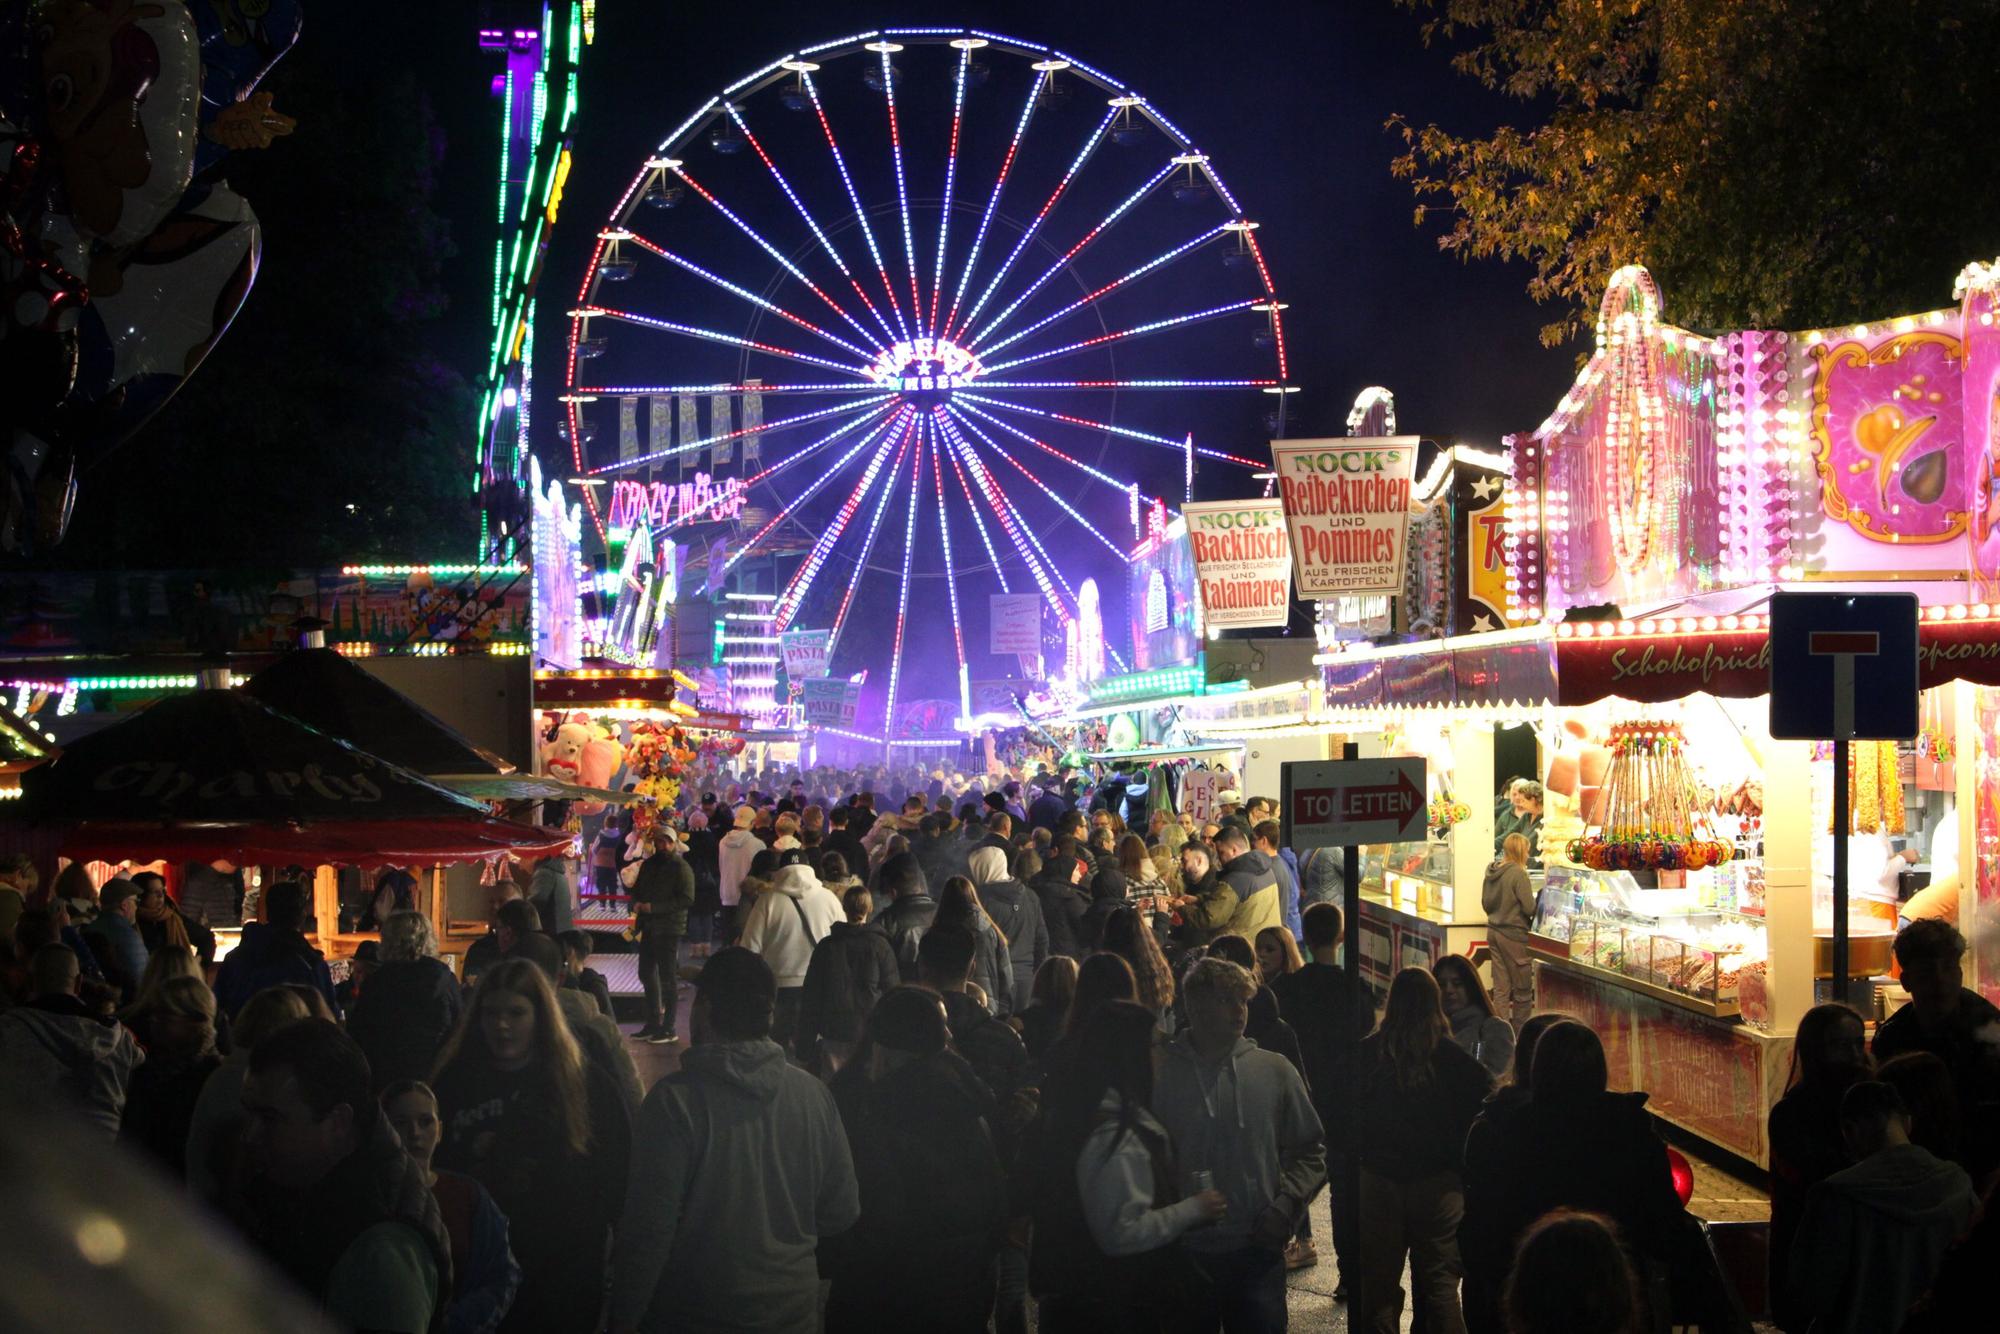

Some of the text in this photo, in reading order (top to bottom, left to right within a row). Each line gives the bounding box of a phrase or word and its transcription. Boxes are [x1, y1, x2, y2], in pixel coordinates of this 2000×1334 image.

[619, 472, 748, 530] CRAZY MOUSE
[1280, 473, 1410, 517] Reibekuchen
[1329, 517, 1366, 527] UND
[1192, 527, 1288, 562] Backfisch
[1300, 525, 1395, 566] Pommes
[1304, 566, 1394, 577] AUS FRISCHEN
[1310, 577, 1388, 587] KARTOFFELN
[1201, 577, 1287, 610] Calamares
[787, 647, 825, 661] PASTA
[1611, 640, 2000, 684] Schokofrüch opcorn
[1302, 791, 1412, 817] TOILETTEN
